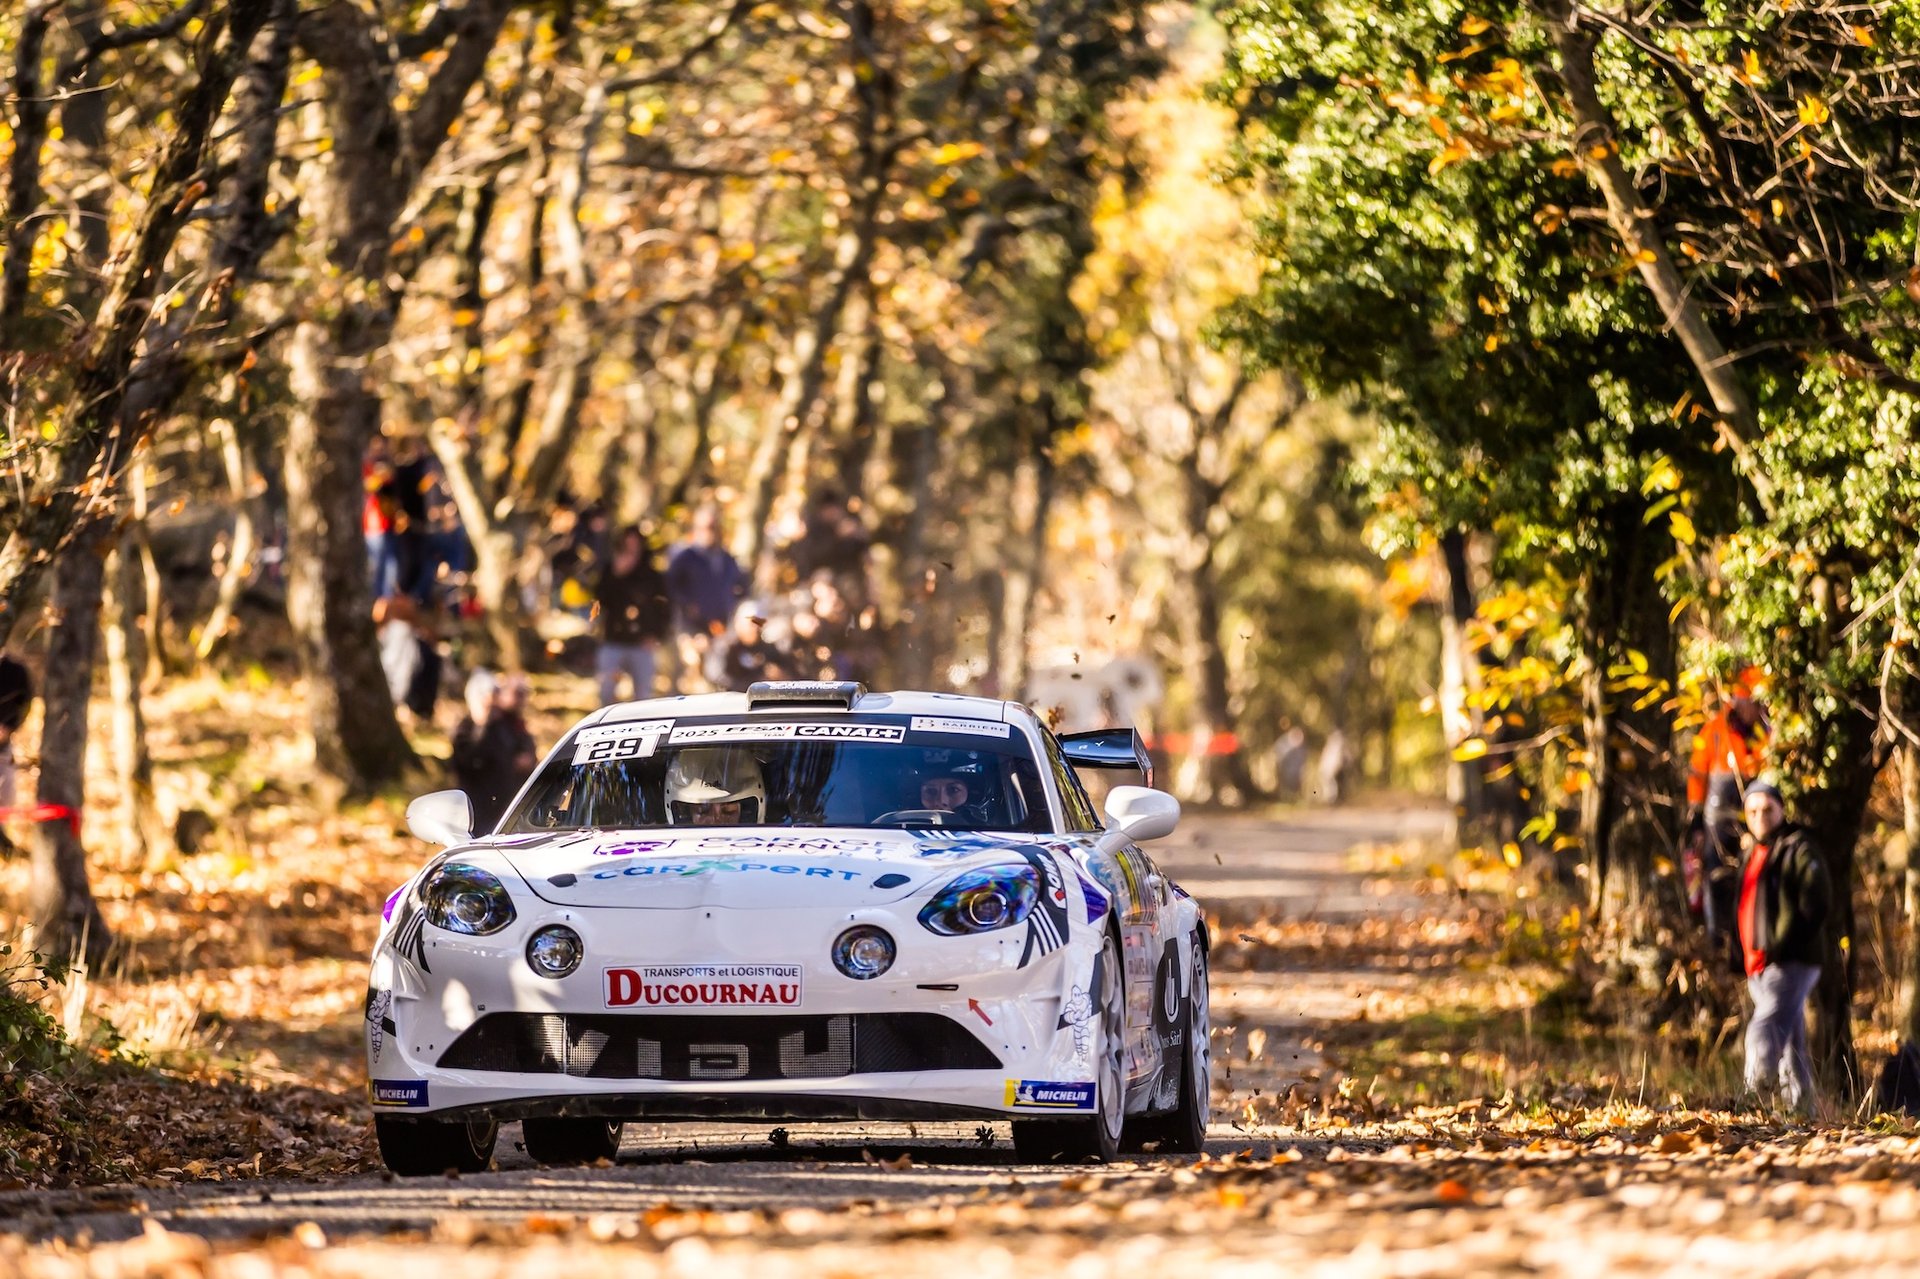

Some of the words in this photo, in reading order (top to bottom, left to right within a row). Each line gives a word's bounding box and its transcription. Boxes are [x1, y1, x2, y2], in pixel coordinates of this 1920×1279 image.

[601, 724, 668, 736] ORECA
[674, 729, 719, 738] 2025
[725, 725, 787, 733] FFSA
[798, 725, 900, 739] CANAL+
[588, 738, 642, 760] 29
[698, 842, 895, 854] CORNUT
[702, 836, 900, 849] GARAGE
[644, 967, 715, 977] TRANSPORTS
[718, 969, 729, 977] et
[731, 967, 799, 977] LOGISTIQUE
[380, 1089, 418, 1099] MICHELIN
[1036, 1090, 1088, 1101] MICHELIN
